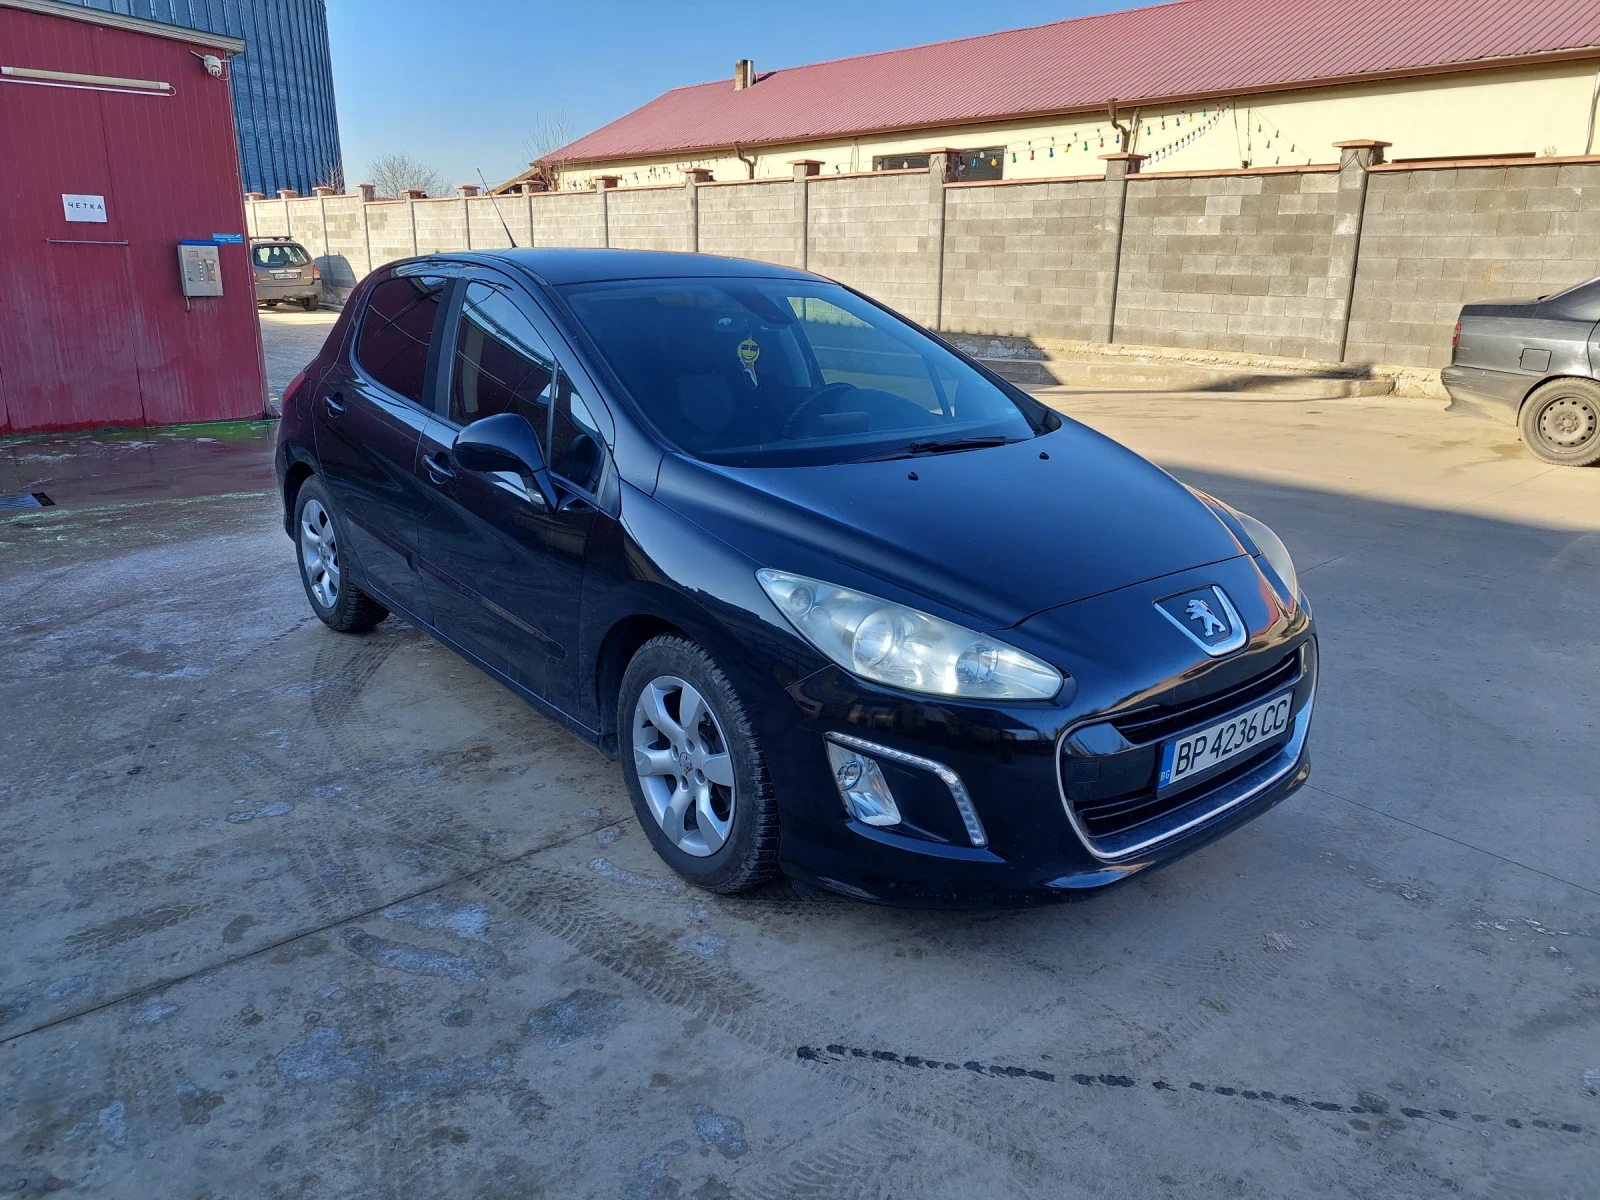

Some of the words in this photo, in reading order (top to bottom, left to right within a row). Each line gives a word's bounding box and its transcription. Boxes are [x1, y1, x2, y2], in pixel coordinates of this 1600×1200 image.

[67, 202, 103, 210] ЧЕТКА
[1175, 735, 1207, 776] BP
[1210, 712, 1259, 759] 4236
[1261, 699, 1288, 736] CC
[1160, 769, 1171, 782] BG
